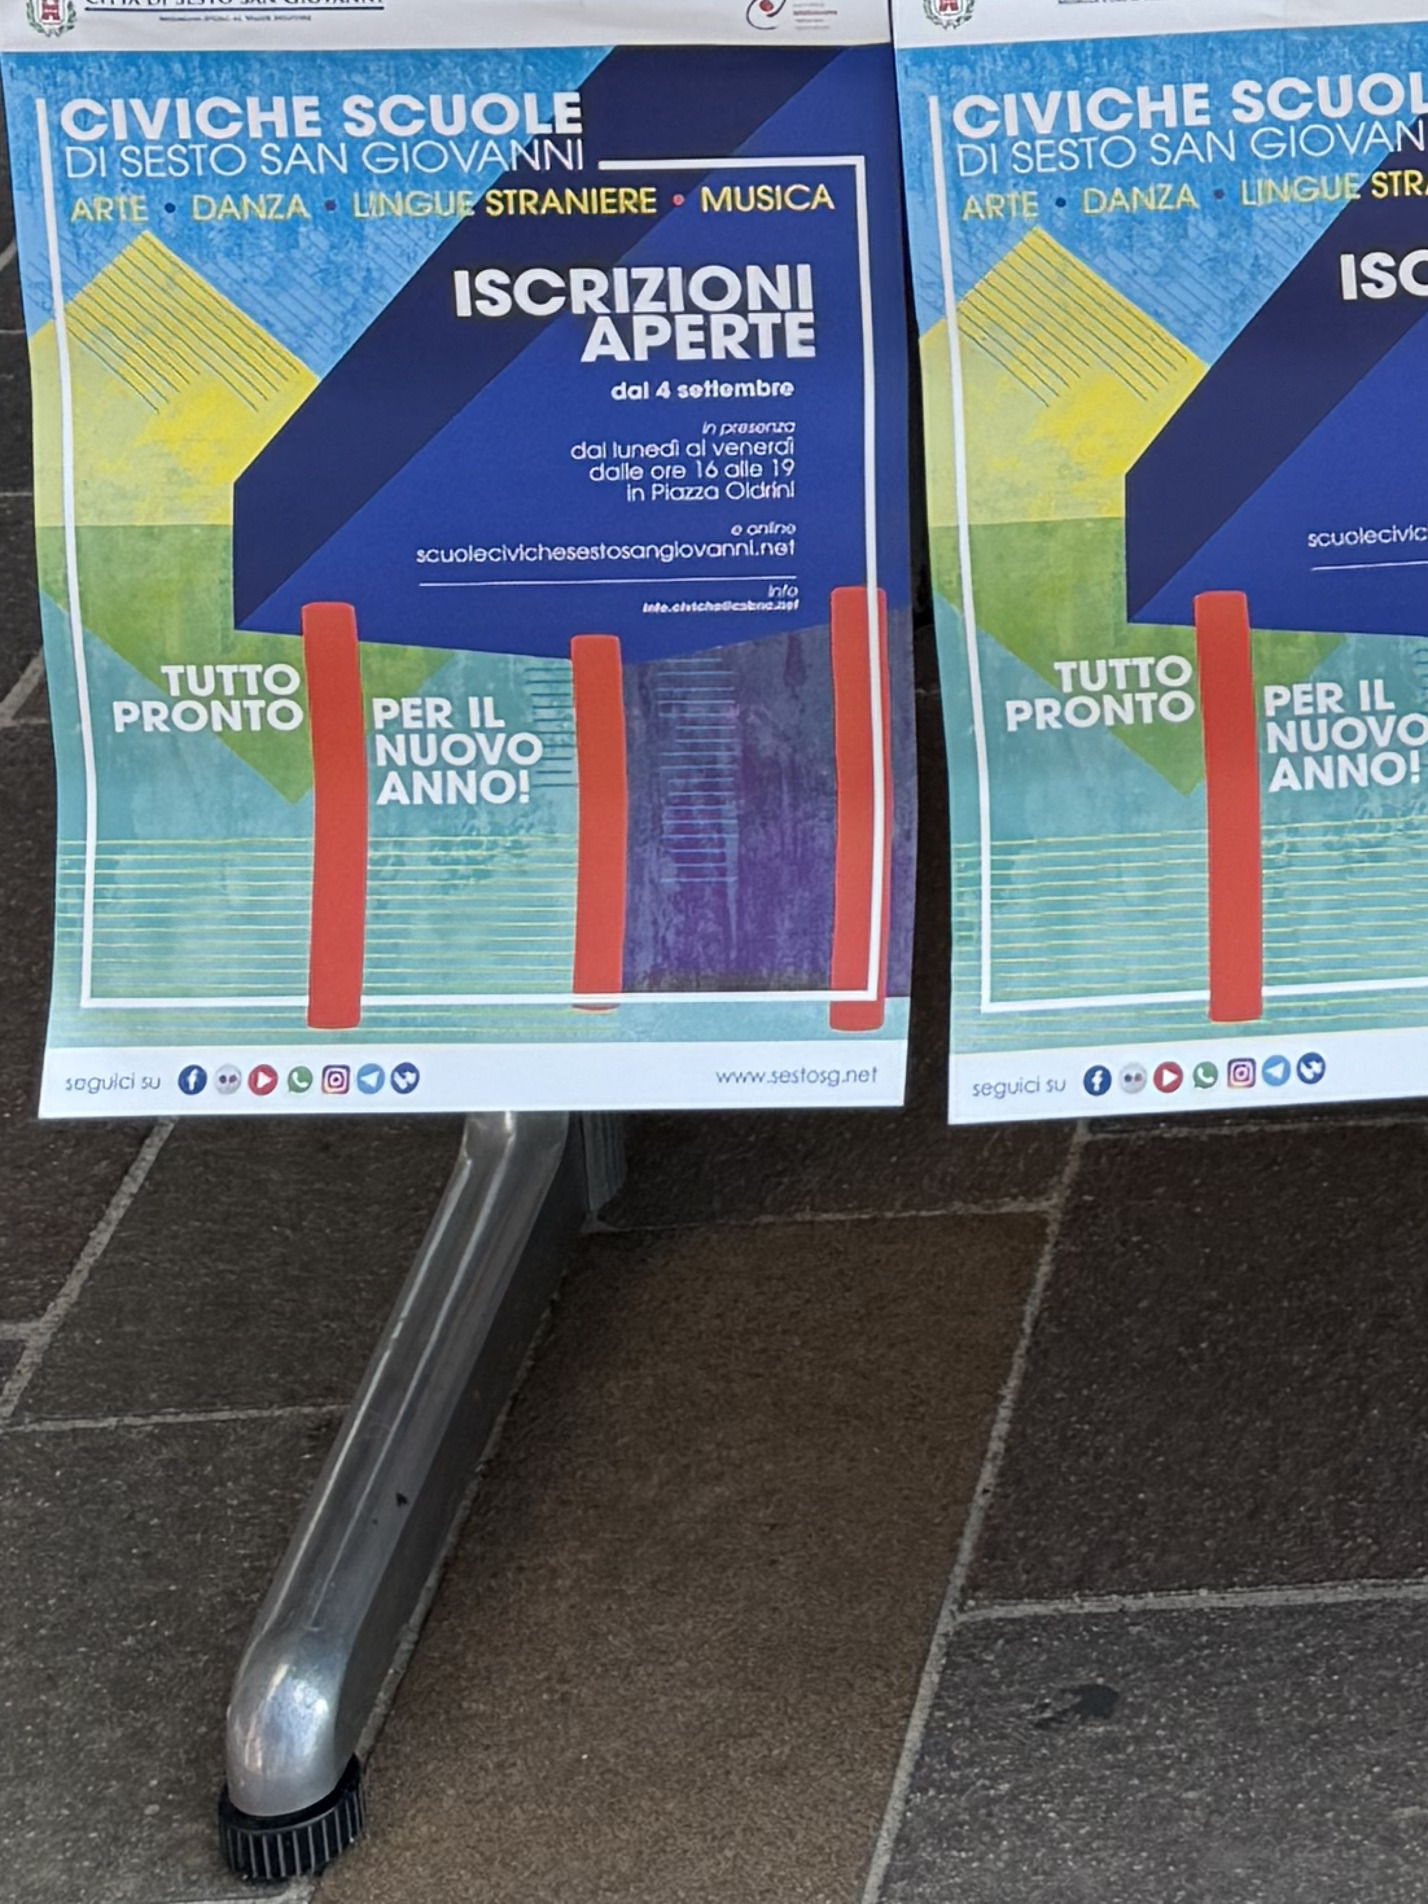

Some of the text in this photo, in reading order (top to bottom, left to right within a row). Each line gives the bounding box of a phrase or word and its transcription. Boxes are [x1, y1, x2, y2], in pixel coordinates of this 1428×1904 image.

[59, 90, 582, 140] CIVICHE SCUOLE
[952, 84, 1210, 138] CIVICHE
[65, 138, 585, 178] DI SESTO SAN GIOVANNI
[957, 141, 1004, 176] DI
[1009, 134, 1136, 173] SESTO
[1148, 128, 1236, 166] SAN
[960, 191, 1037, 221] ARTE
[1083, 182, 1198, 216] DANZA
[1239, 172, 1361, 206] LINGUE
[452, 264, 815, 317] ISCRIZIONI
[577, 312, 818, 362] APERTE
[160, 662, 301, 698] TUTTO
[1053, 653, 1193, 695] TUTTO
[112, 698, 305, 734] PRONTO
[371, 696, 505, 732] PER IL
[1005, 688, 1196, 733] PRONTO
[1263, 678, 1395, 720] PER IL
[374, 730, 545, 770] NUOVO
[1267, 748, 1421, 794] ANNO!
[376, 768, 531, 807] ANNO!
